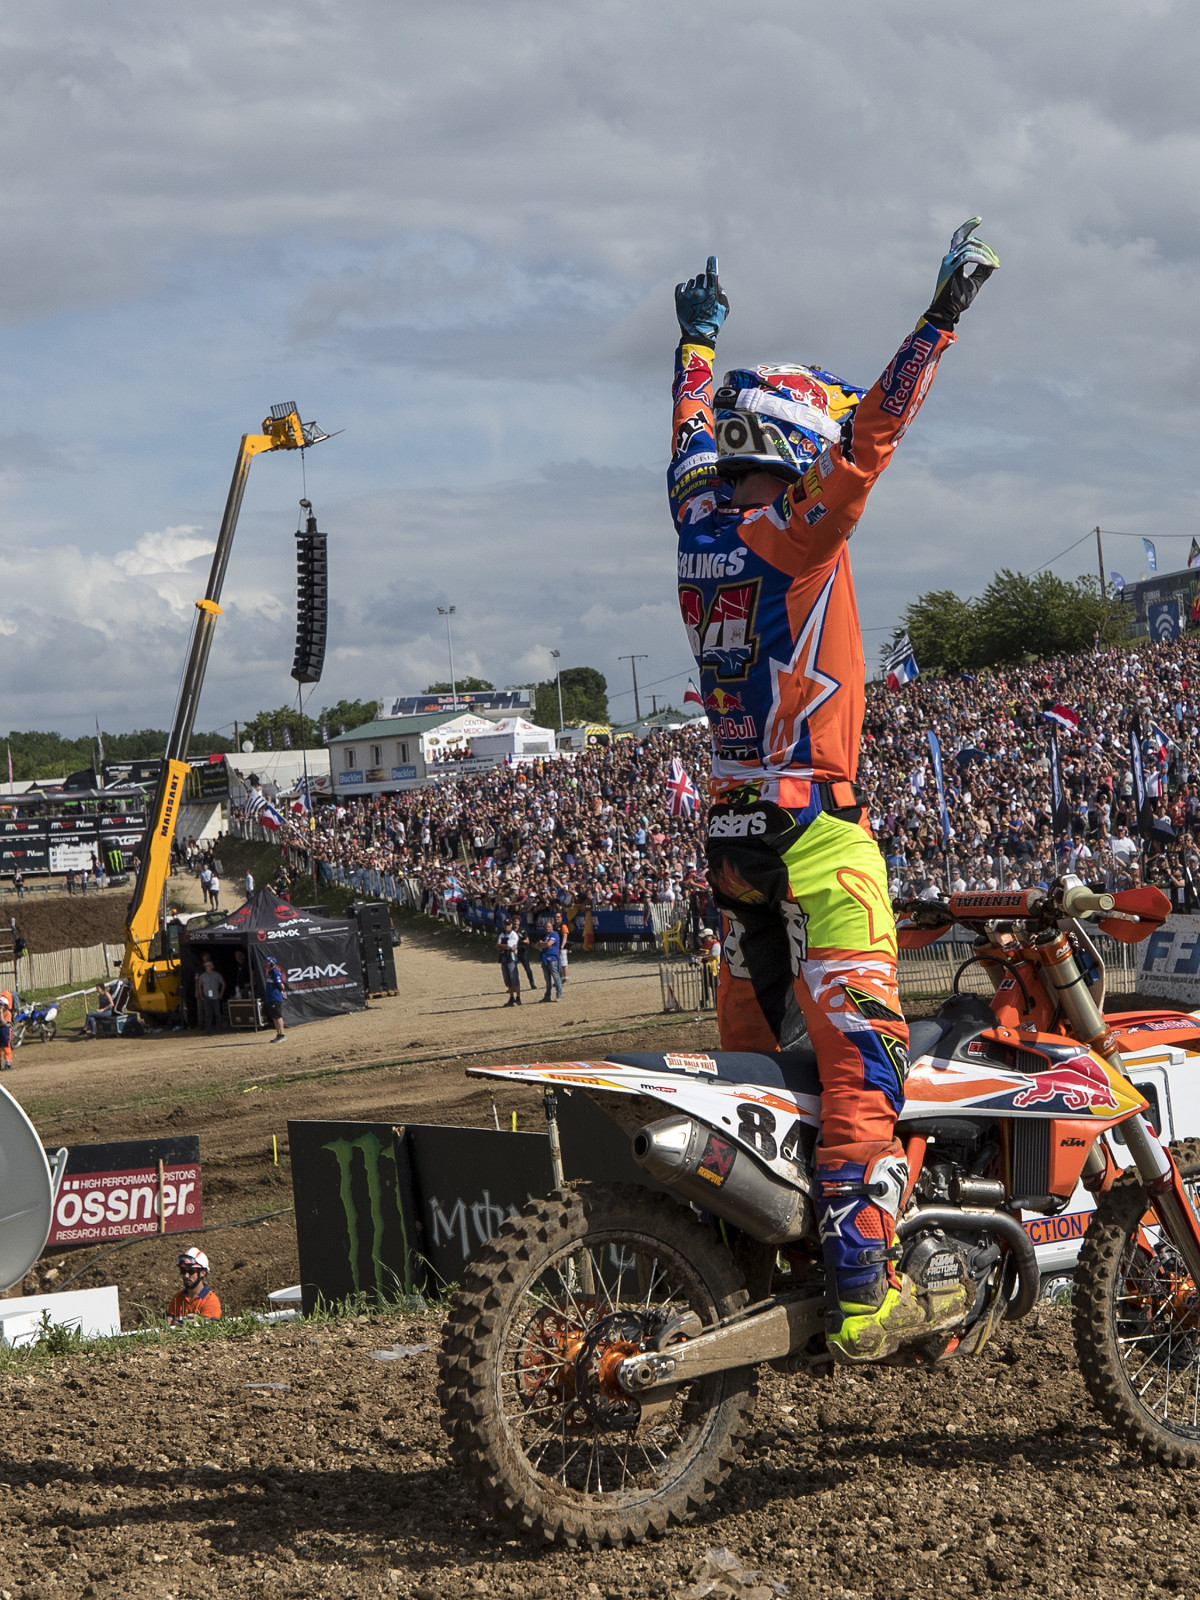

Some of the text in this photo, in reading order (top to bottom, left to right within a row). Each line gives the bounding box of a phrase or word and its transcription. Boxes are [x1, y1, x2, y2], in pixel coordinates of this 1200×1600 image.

[882, 370, 919, 415] Red
[902, 336, 933, 379] Bull
[464, 719, 488, 727] CENTRE
[727, 715, 757, 739] Bull
[340, 773, 362, 785] Buckler
[392, 768, 416, 779] Buckler
[160, 774, 180, 838] MAISSANT
[955, 894, 1024, 908] RENTHAL
[267, 928, 300, 939] 24MX
[287, 962, 348, 983] 24MX
[1060, 1137, 1086, 1147] KTM
[80, 1179, 101, 1189] HIGH
[101, 1173, 158, 1187] PERFORMANC
[56, 1229, 99, 1241] RESEARCH
[100, 1227, 107, 1237] &
